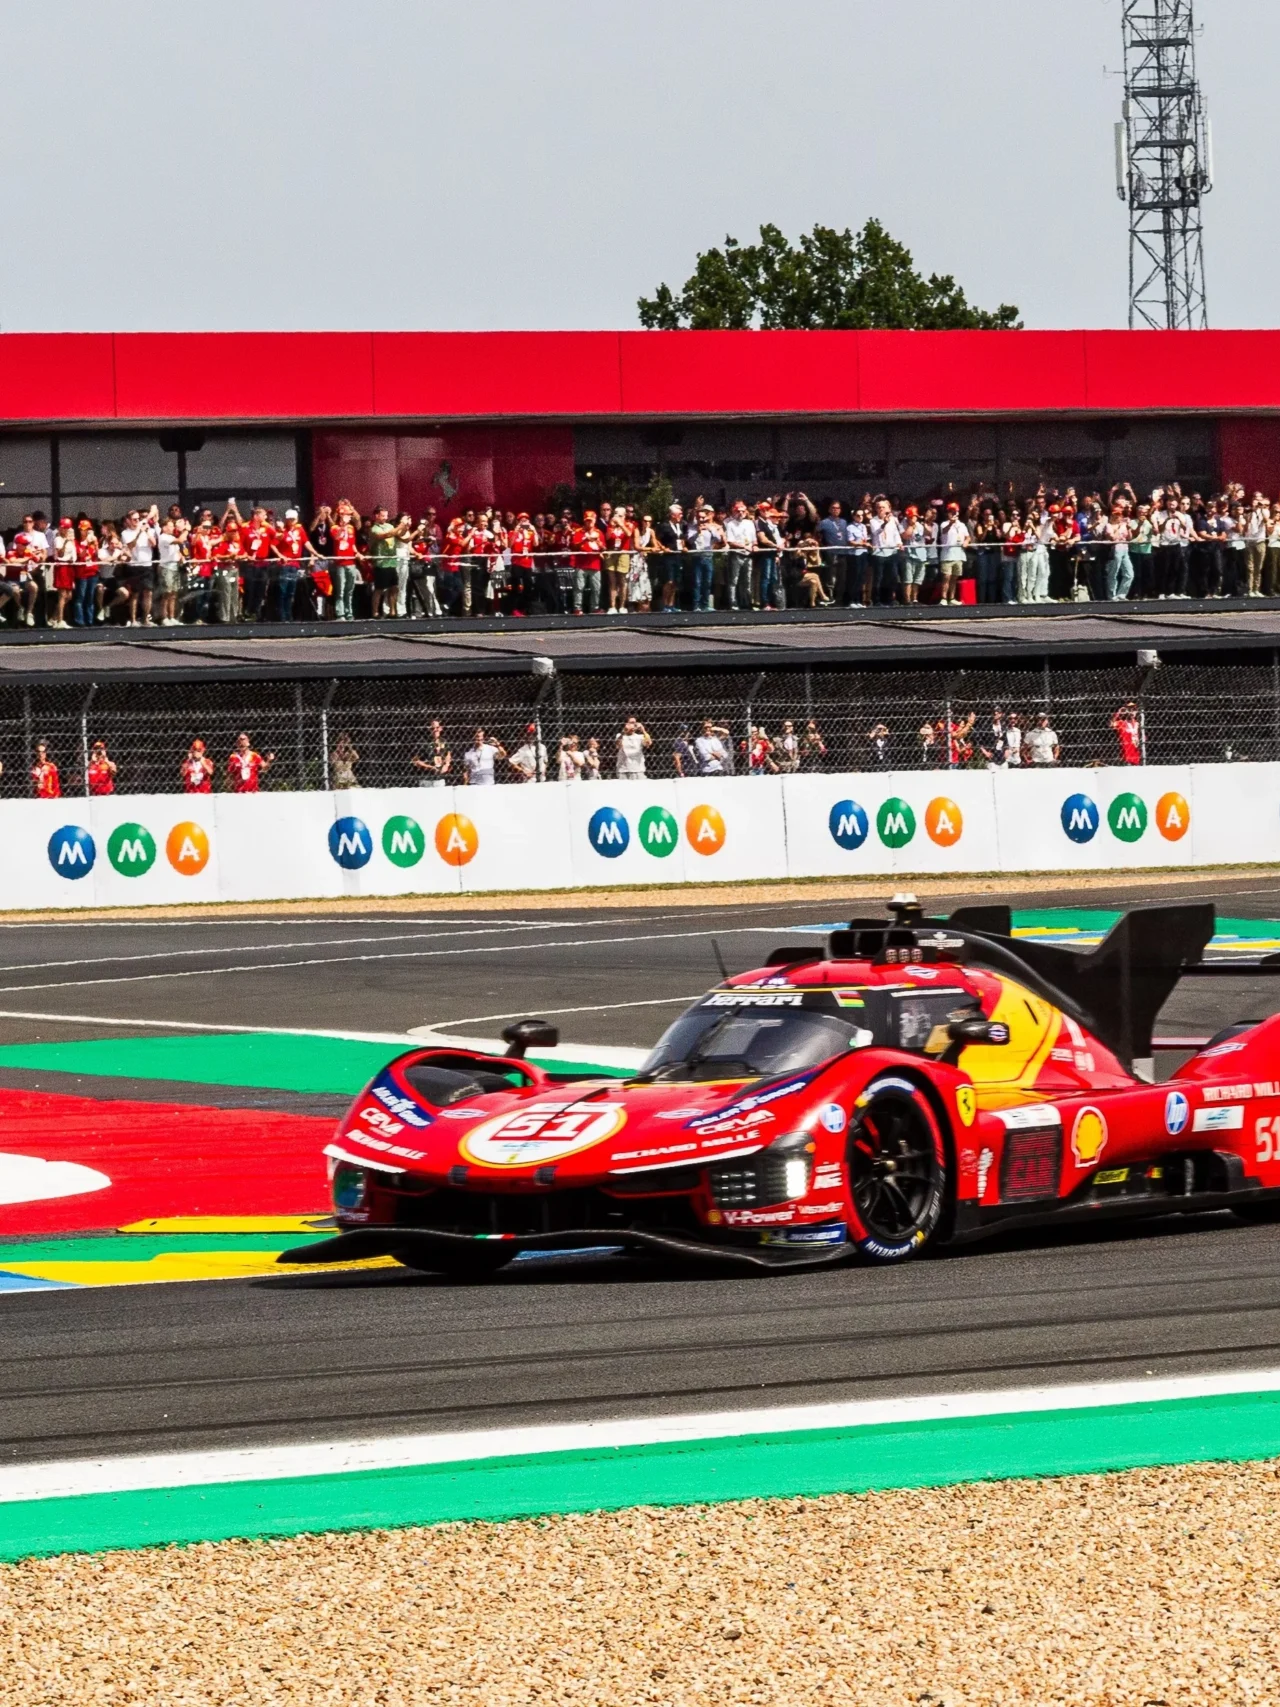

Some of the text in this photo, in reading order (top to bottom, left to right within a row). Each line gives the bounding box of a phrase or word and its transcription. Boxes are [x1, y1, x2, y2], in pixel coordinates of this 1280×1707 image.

[594, 817, 718, 847] MMA
[834, 809, 956, 839] MMA
[1066, 803, 1183, 833] MMA
[55, 835, 202, 867] MMA
[335, 825, 469, 858] MMA
[700, 992, 804, 1007] Ferrari
[1202, 1083, 1254, 1102] RICHARD
[493, 1112, 597, 1140] 51
[610, 1129, 761, 1161] RICHARD MILLE
[723, 1208, 796, 1225] V-Power
